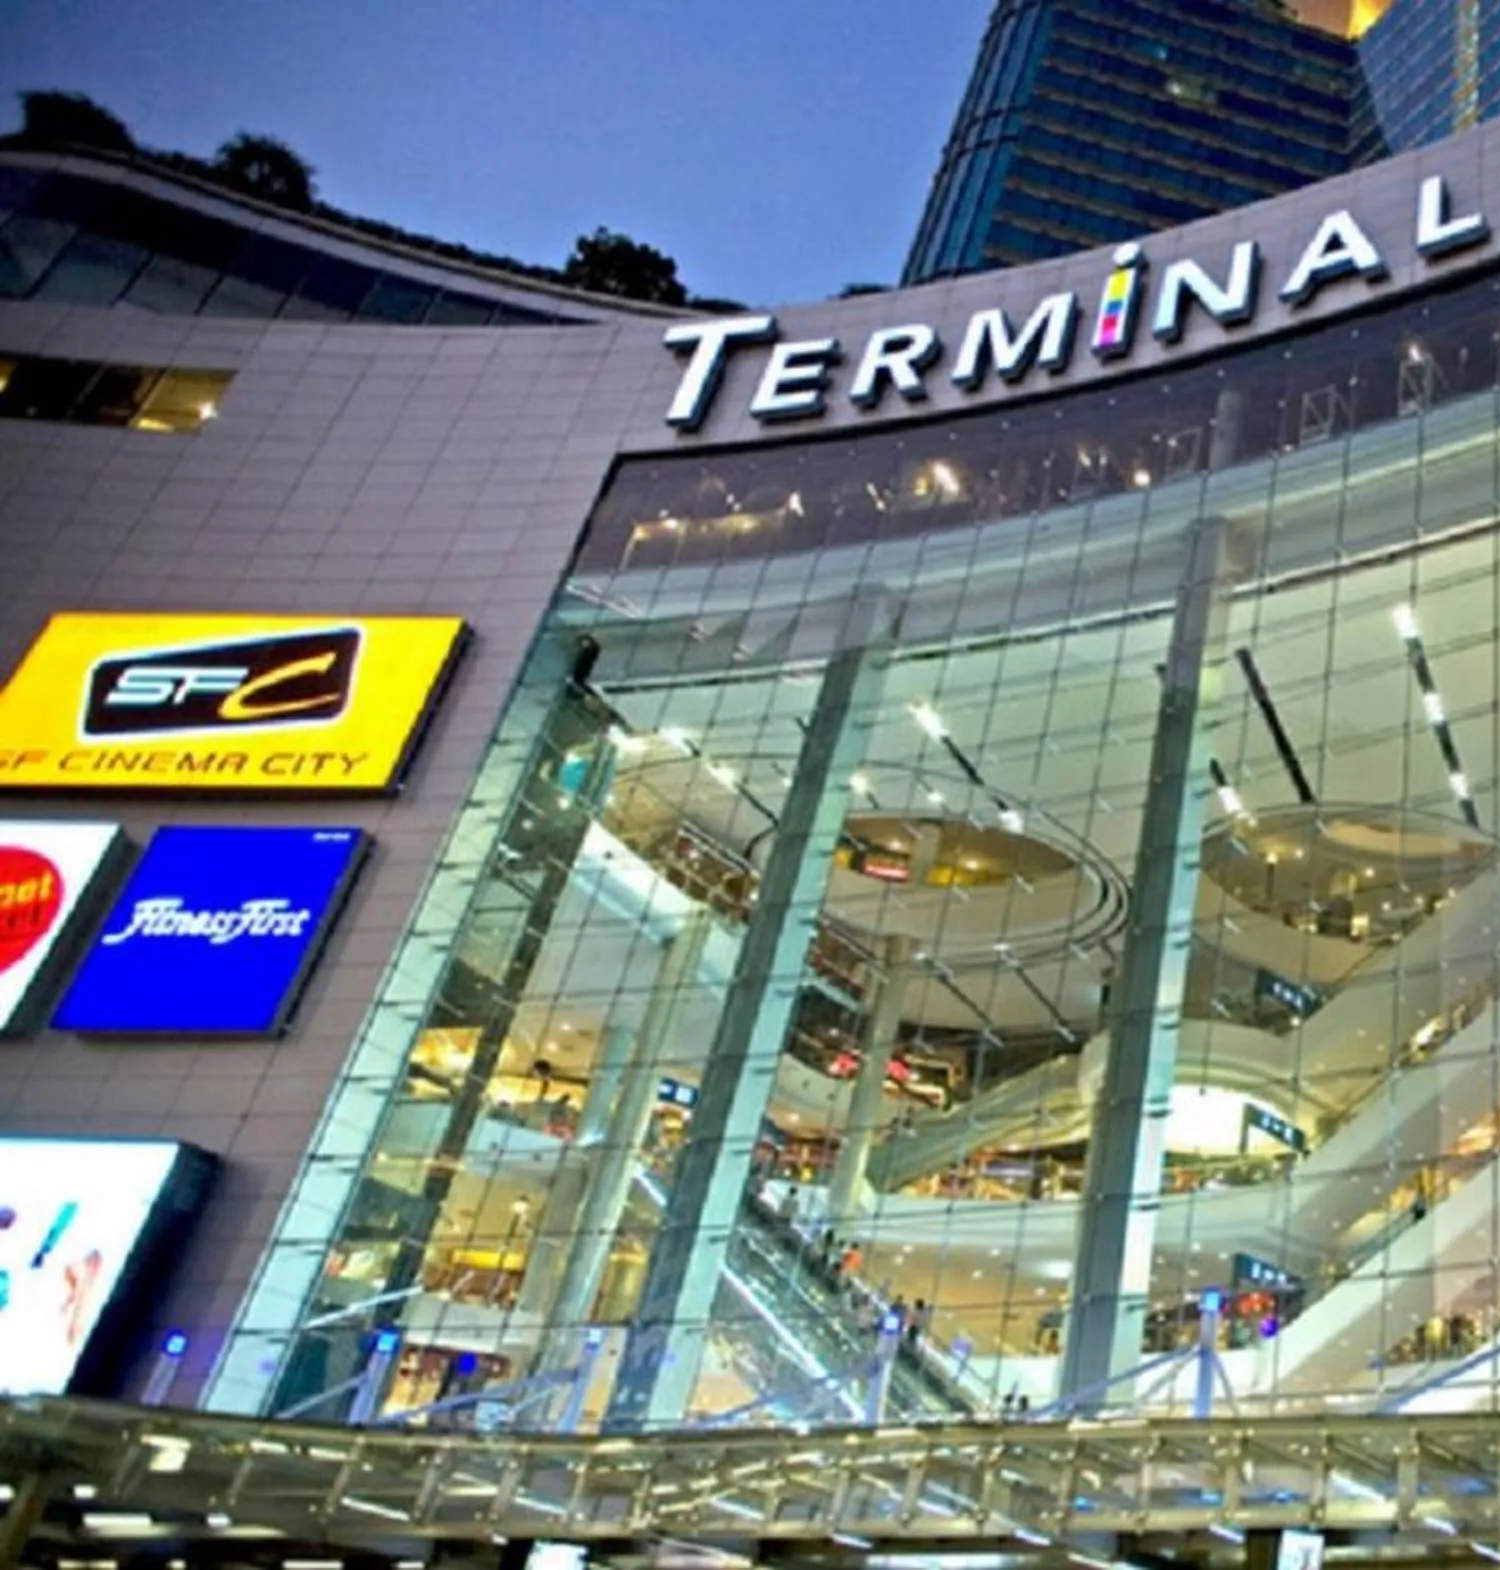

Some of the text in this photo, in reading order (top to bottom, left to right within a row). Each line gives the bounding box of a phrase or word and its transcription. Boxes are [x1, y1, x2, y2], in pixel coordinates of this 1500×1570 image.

[104, 652, 342, 720] SFC
[58, 749, 250, 775] CINEMA
[259, 751, 370, 777] CITY
